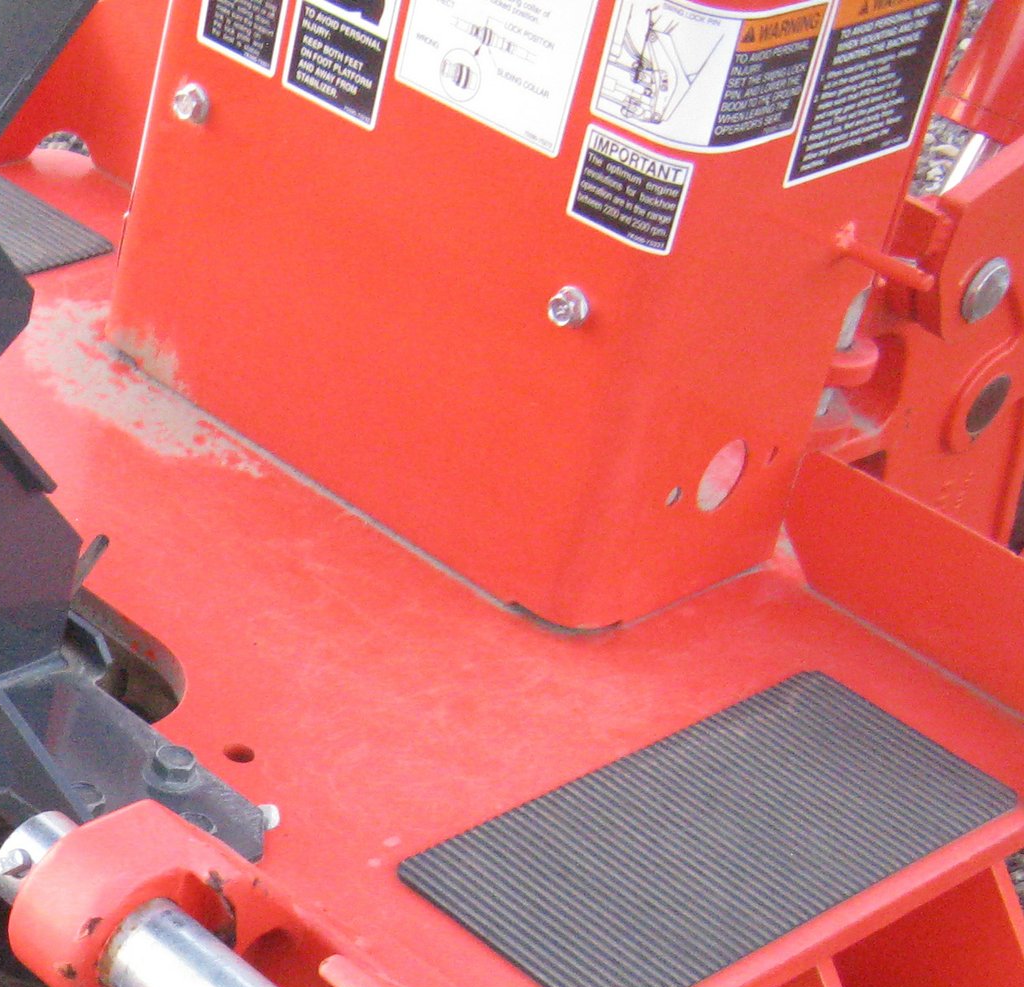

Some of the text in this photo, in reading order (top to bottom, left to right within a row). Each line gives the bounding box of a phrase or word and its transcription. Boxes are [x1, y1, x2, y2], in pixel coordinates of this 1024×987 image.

[305, 6, 381, 52] TO AVOID PERSONAL
[504, 22, 555, 50] LOCK POSITION
[759, 12, 821, 41] WARNING
[301, 46, 373, 89] ON FOOT PLATFORM
[303, 34, 364, 71] KEEP BOTH FEET
[736, 53, 749, 64] TO
[296, 70, 337, 99] STABILIZER.
[298, 59, 358, 95] AND AWAY FROM
[496, 68, 550, 99] SLIDING COLLAR
[727, 77, 747, 88] SET
[718, 111, 744, 123] WHEN
[720, 100, 748, 112] BOOM
[588, 152, 680, 198] The optimum engine
[593, 136, 682, 182] IMPORTANT
[580, 180, 672, 225] operation are in the range
[583, 167, 676, 211] revolutions for backhoe
[577, 191, 603, 211] between
[619, 212, 632, 225] and
